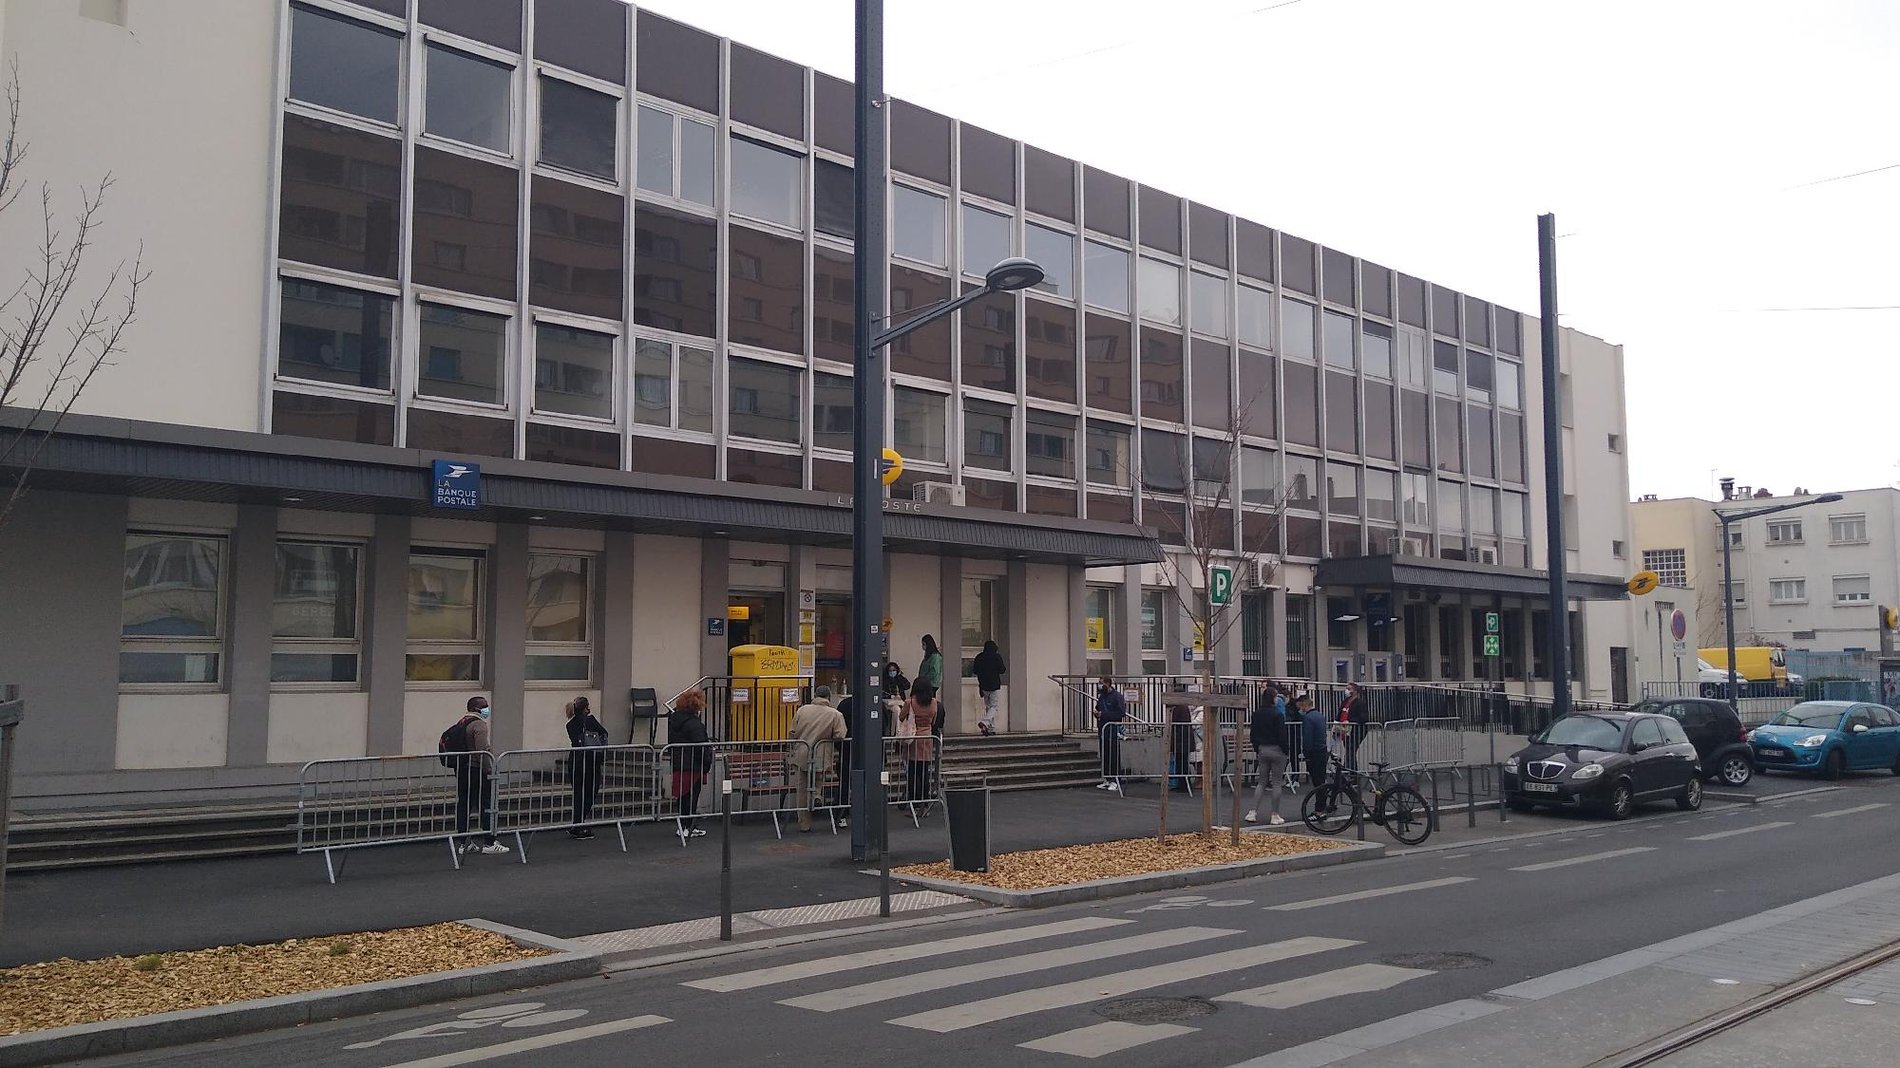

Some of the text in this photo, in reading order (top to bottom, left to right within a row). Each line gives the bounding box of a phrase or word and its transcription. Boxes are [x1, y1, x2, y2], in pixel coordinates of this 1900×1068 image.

[437, 488, 477, 498] BANQUE
[437, 496, 476, 506] POSTALE
[882, 500, 921, 512] OSTE
[1216, 573, 1227, 597] P
